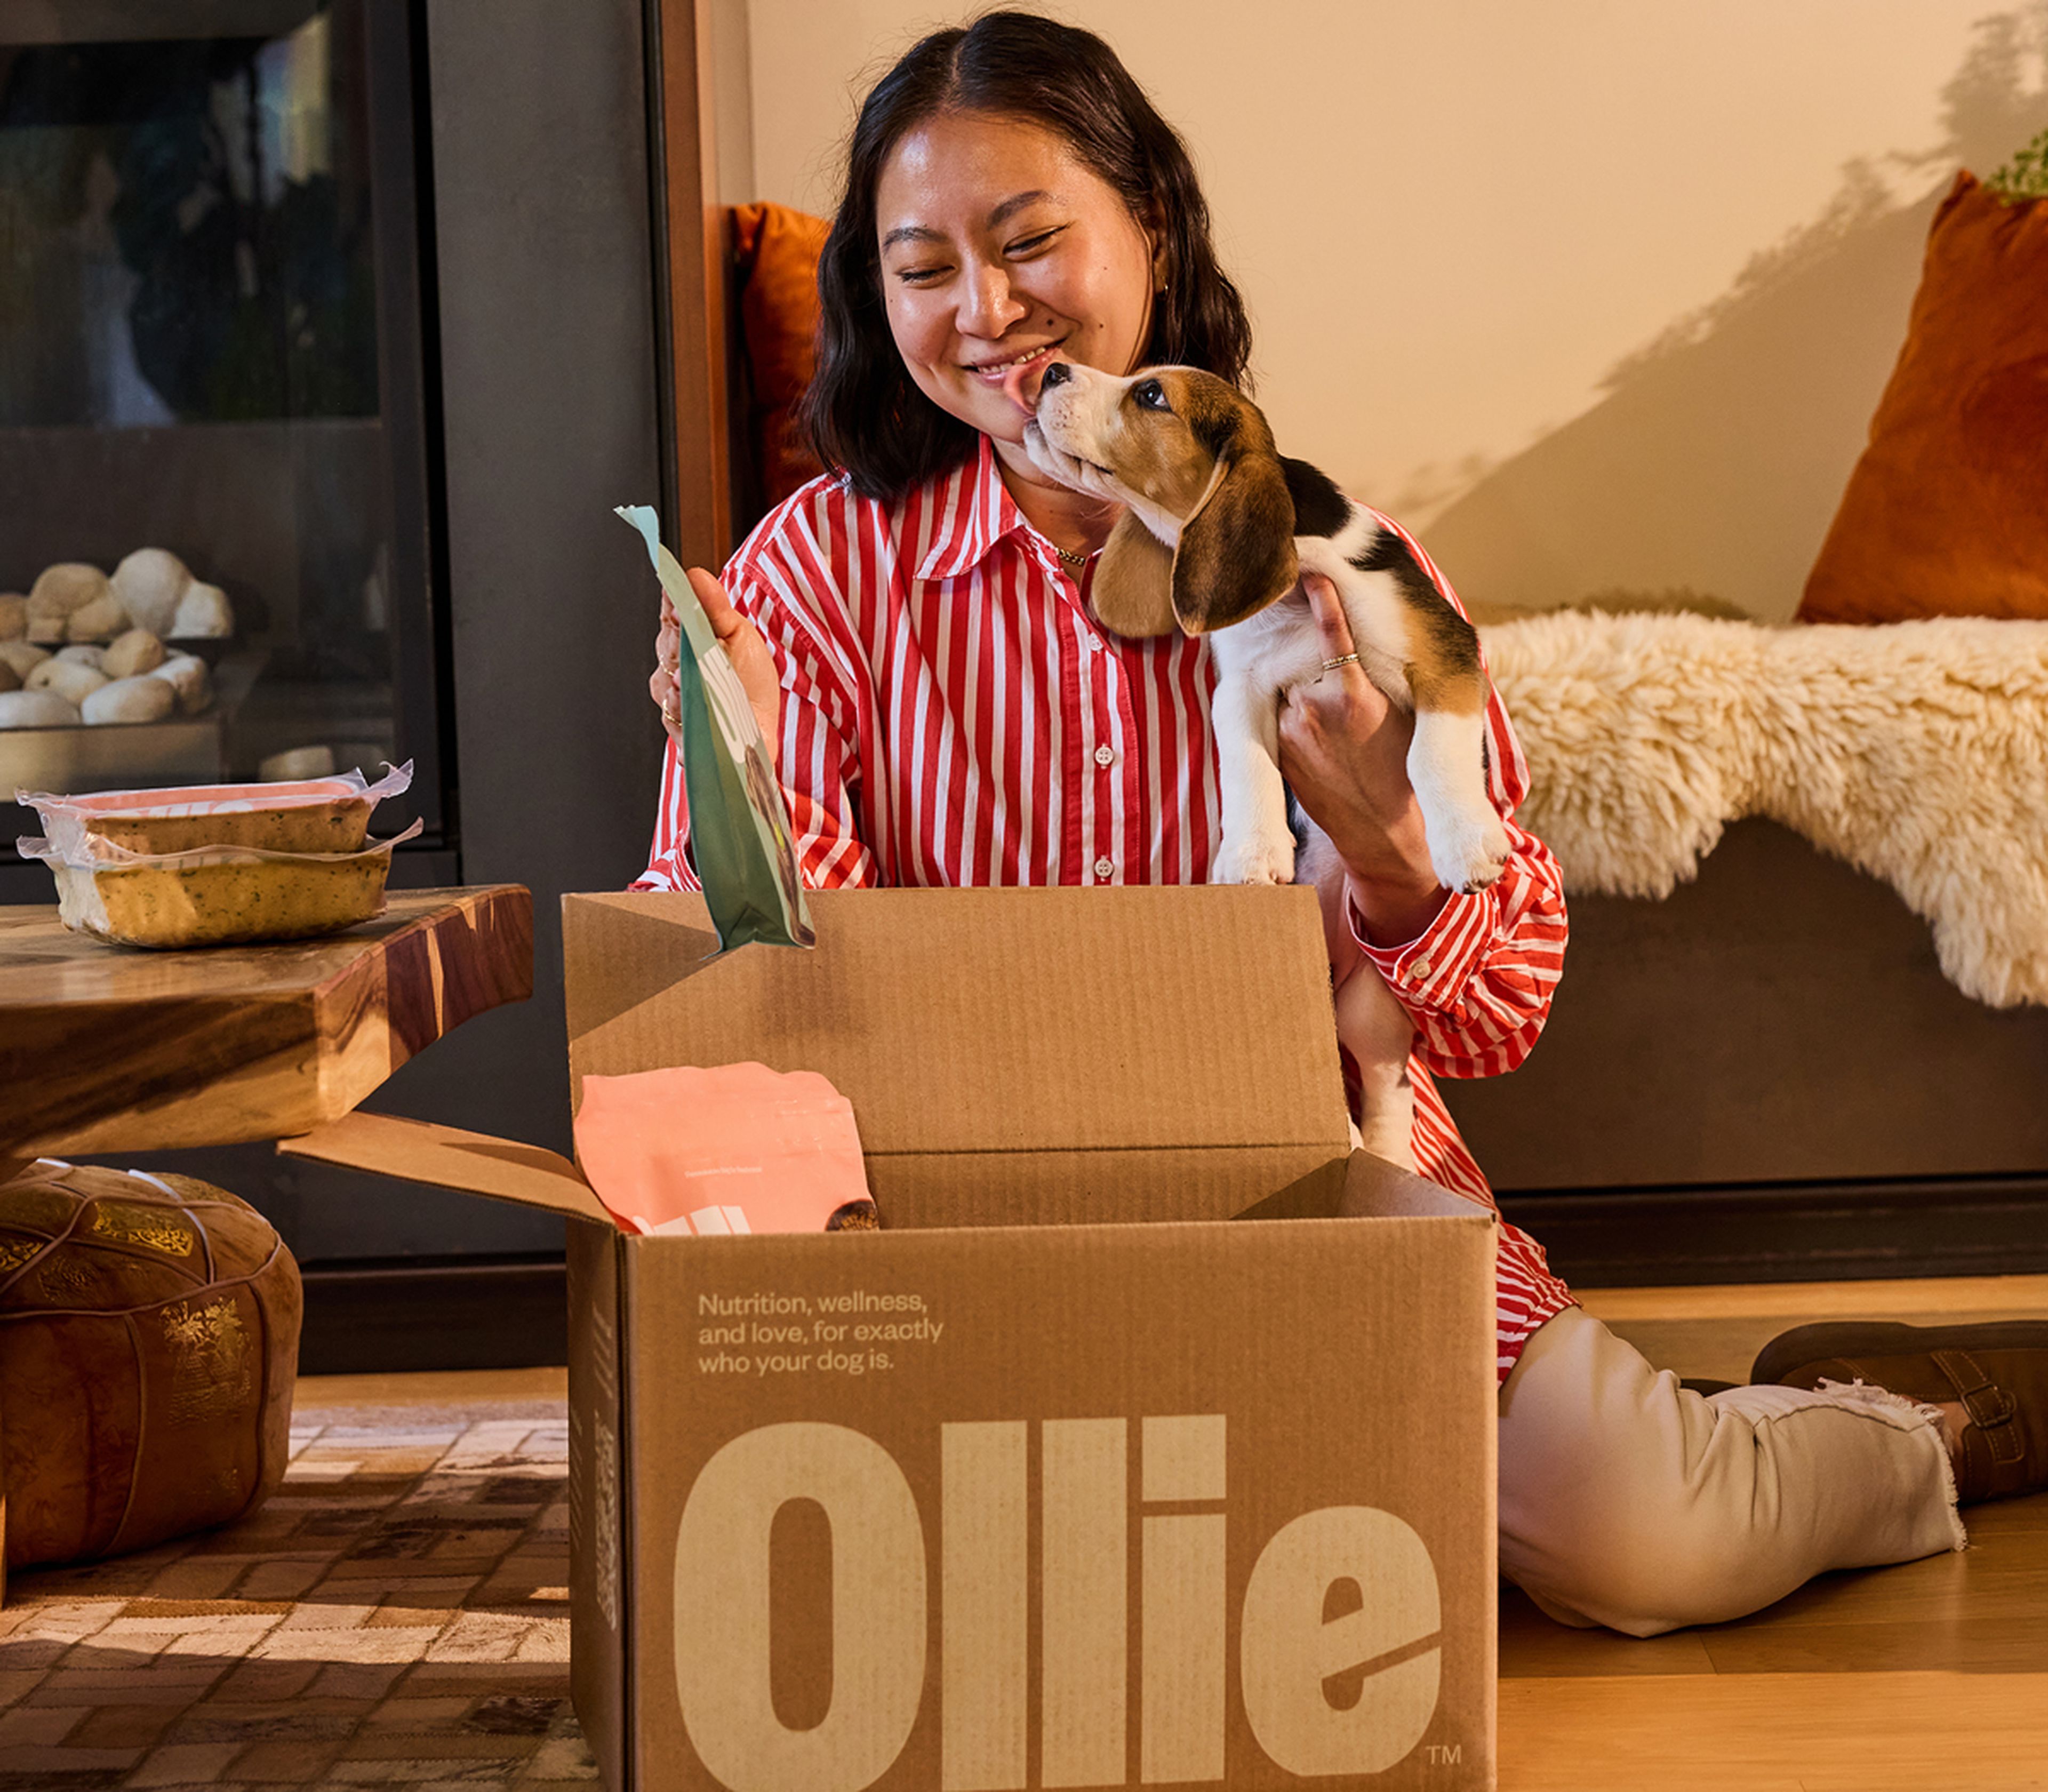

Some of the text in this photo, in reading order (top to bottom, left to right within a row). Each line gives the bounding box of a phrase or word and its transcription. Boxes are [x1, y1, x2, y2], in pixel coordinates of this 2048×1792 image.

[699, 1290, 927, 1316] Nutrition, wellness,
[699, 1317, 943, 1345] and love, for exactly
[699, 1348, 894, 1377] who your dog is.
[674, 1415, 1441, 1792] Ollie
[1425, 1744, 1461, 1765] TM
